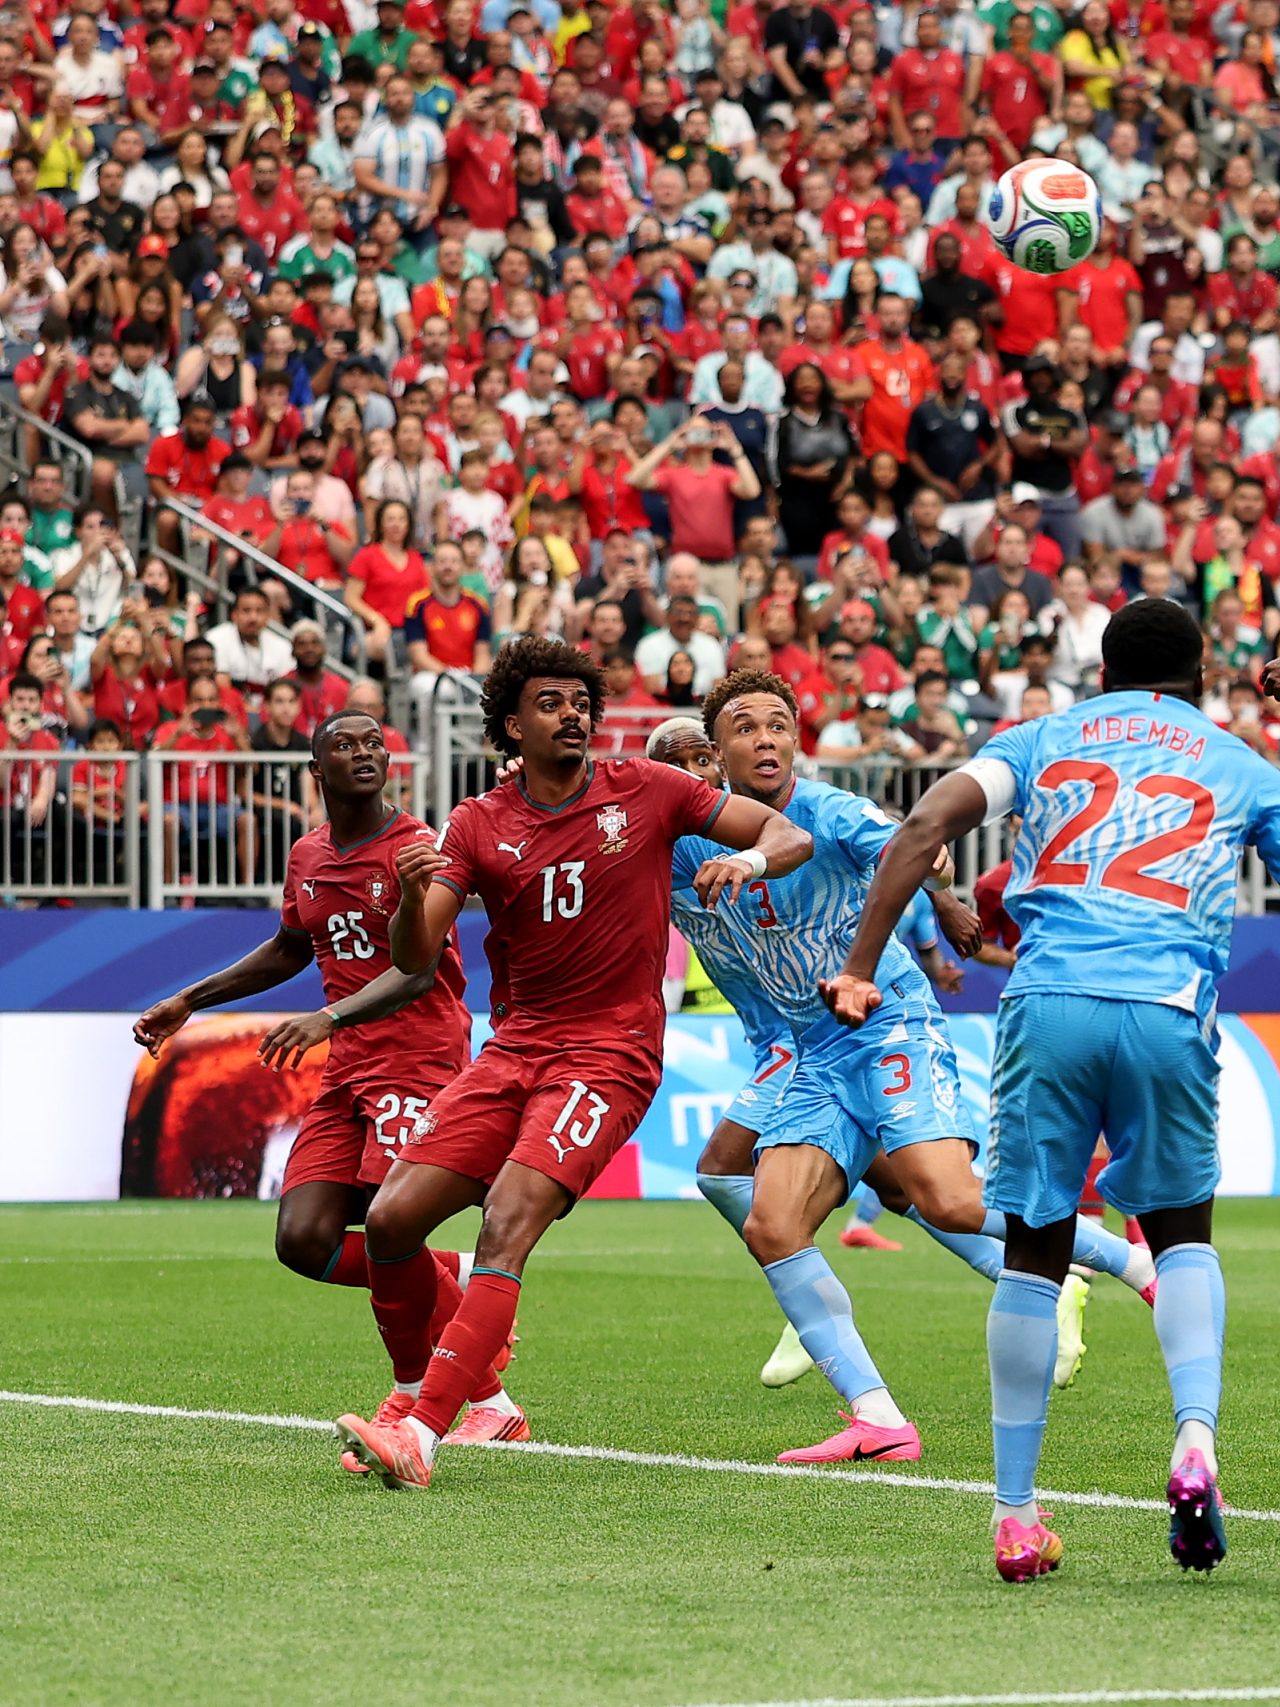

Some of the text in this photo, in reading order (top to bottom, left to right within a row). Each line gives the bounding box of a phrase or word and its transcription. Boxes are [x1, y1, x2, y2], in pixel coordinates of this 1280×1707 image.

[1081, 716, 1208, 762] MBEMBA
[1028, 758, 1217, 913] 22
[538, 860, 586, 923] 13
[748, 879, 778, 931] 3
[327, 911, 376, 961] 25
[753, 1044, 795, 1085] 7
[878, 1052, 913, 1097] 3
[374, 1092, 428, 1146] 25
[551, 1079, 611, 1148] 13
